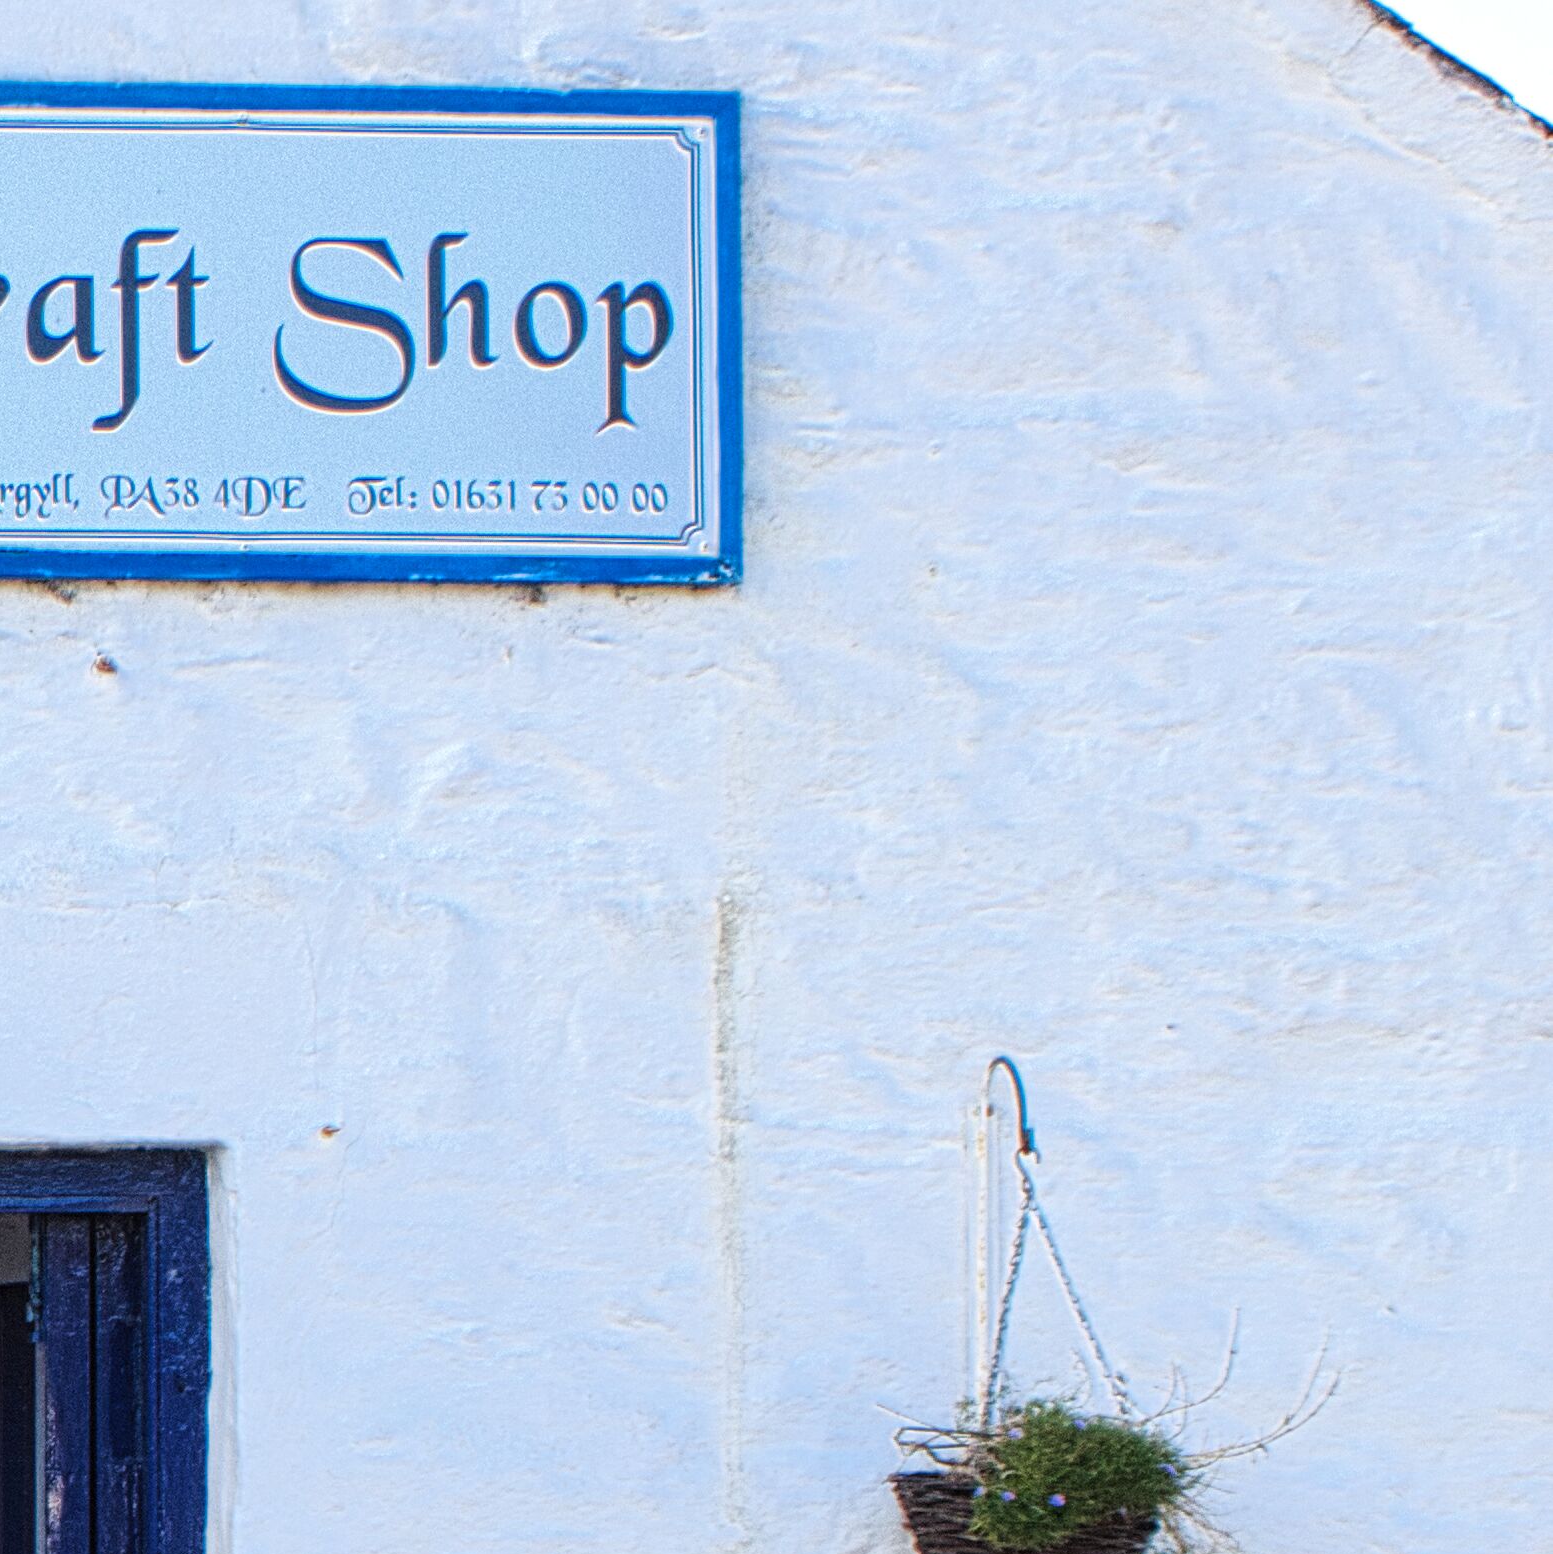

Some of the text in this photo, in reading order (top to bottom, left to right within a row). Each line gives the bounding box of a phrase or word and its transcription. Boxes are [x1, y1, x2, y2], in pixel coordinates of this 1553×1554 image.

[274, 232, 674, 431] Shop
[100, 474, 200, 519] PA38
[214, 475, 307, 518] 4DE
[348, 475, 418, 516] Tel:
[432, 479, 517, 511] 01631
[532, 479, 570, 511] 73
[582, 480, 621, 512] 00
[632, 481, 669, 513] 00
